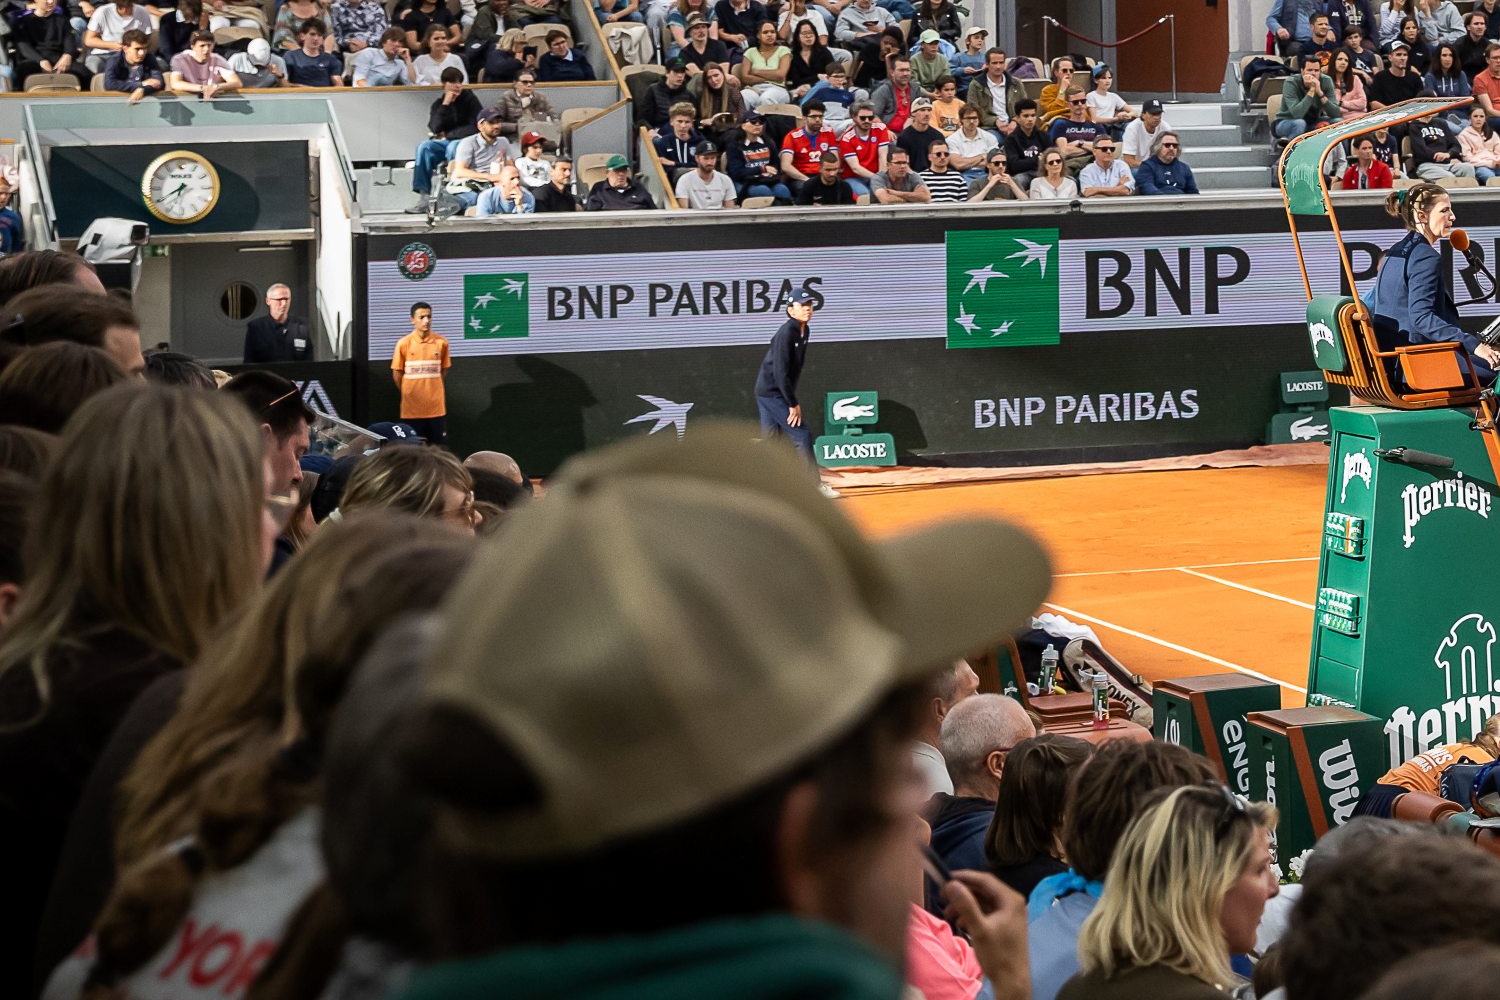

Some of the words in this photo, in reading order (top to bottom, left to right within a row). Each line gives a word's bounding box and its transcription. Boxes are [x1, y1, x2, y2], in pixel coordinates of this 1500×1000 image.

[547, 285, 635, 321] BNP
[648, 276, 825, 318] PARIBAS
[1084, 246, 1251, 320] BNP
[1286, 379, 1324, 393] LACOSTE
[974, 396, 1047, 430] BNP
[1055, 389, 1200, 425] PARIBAS
[823, 441, 887, 461] LACOSTE
[1401, 471, 1491, 549] perrier
